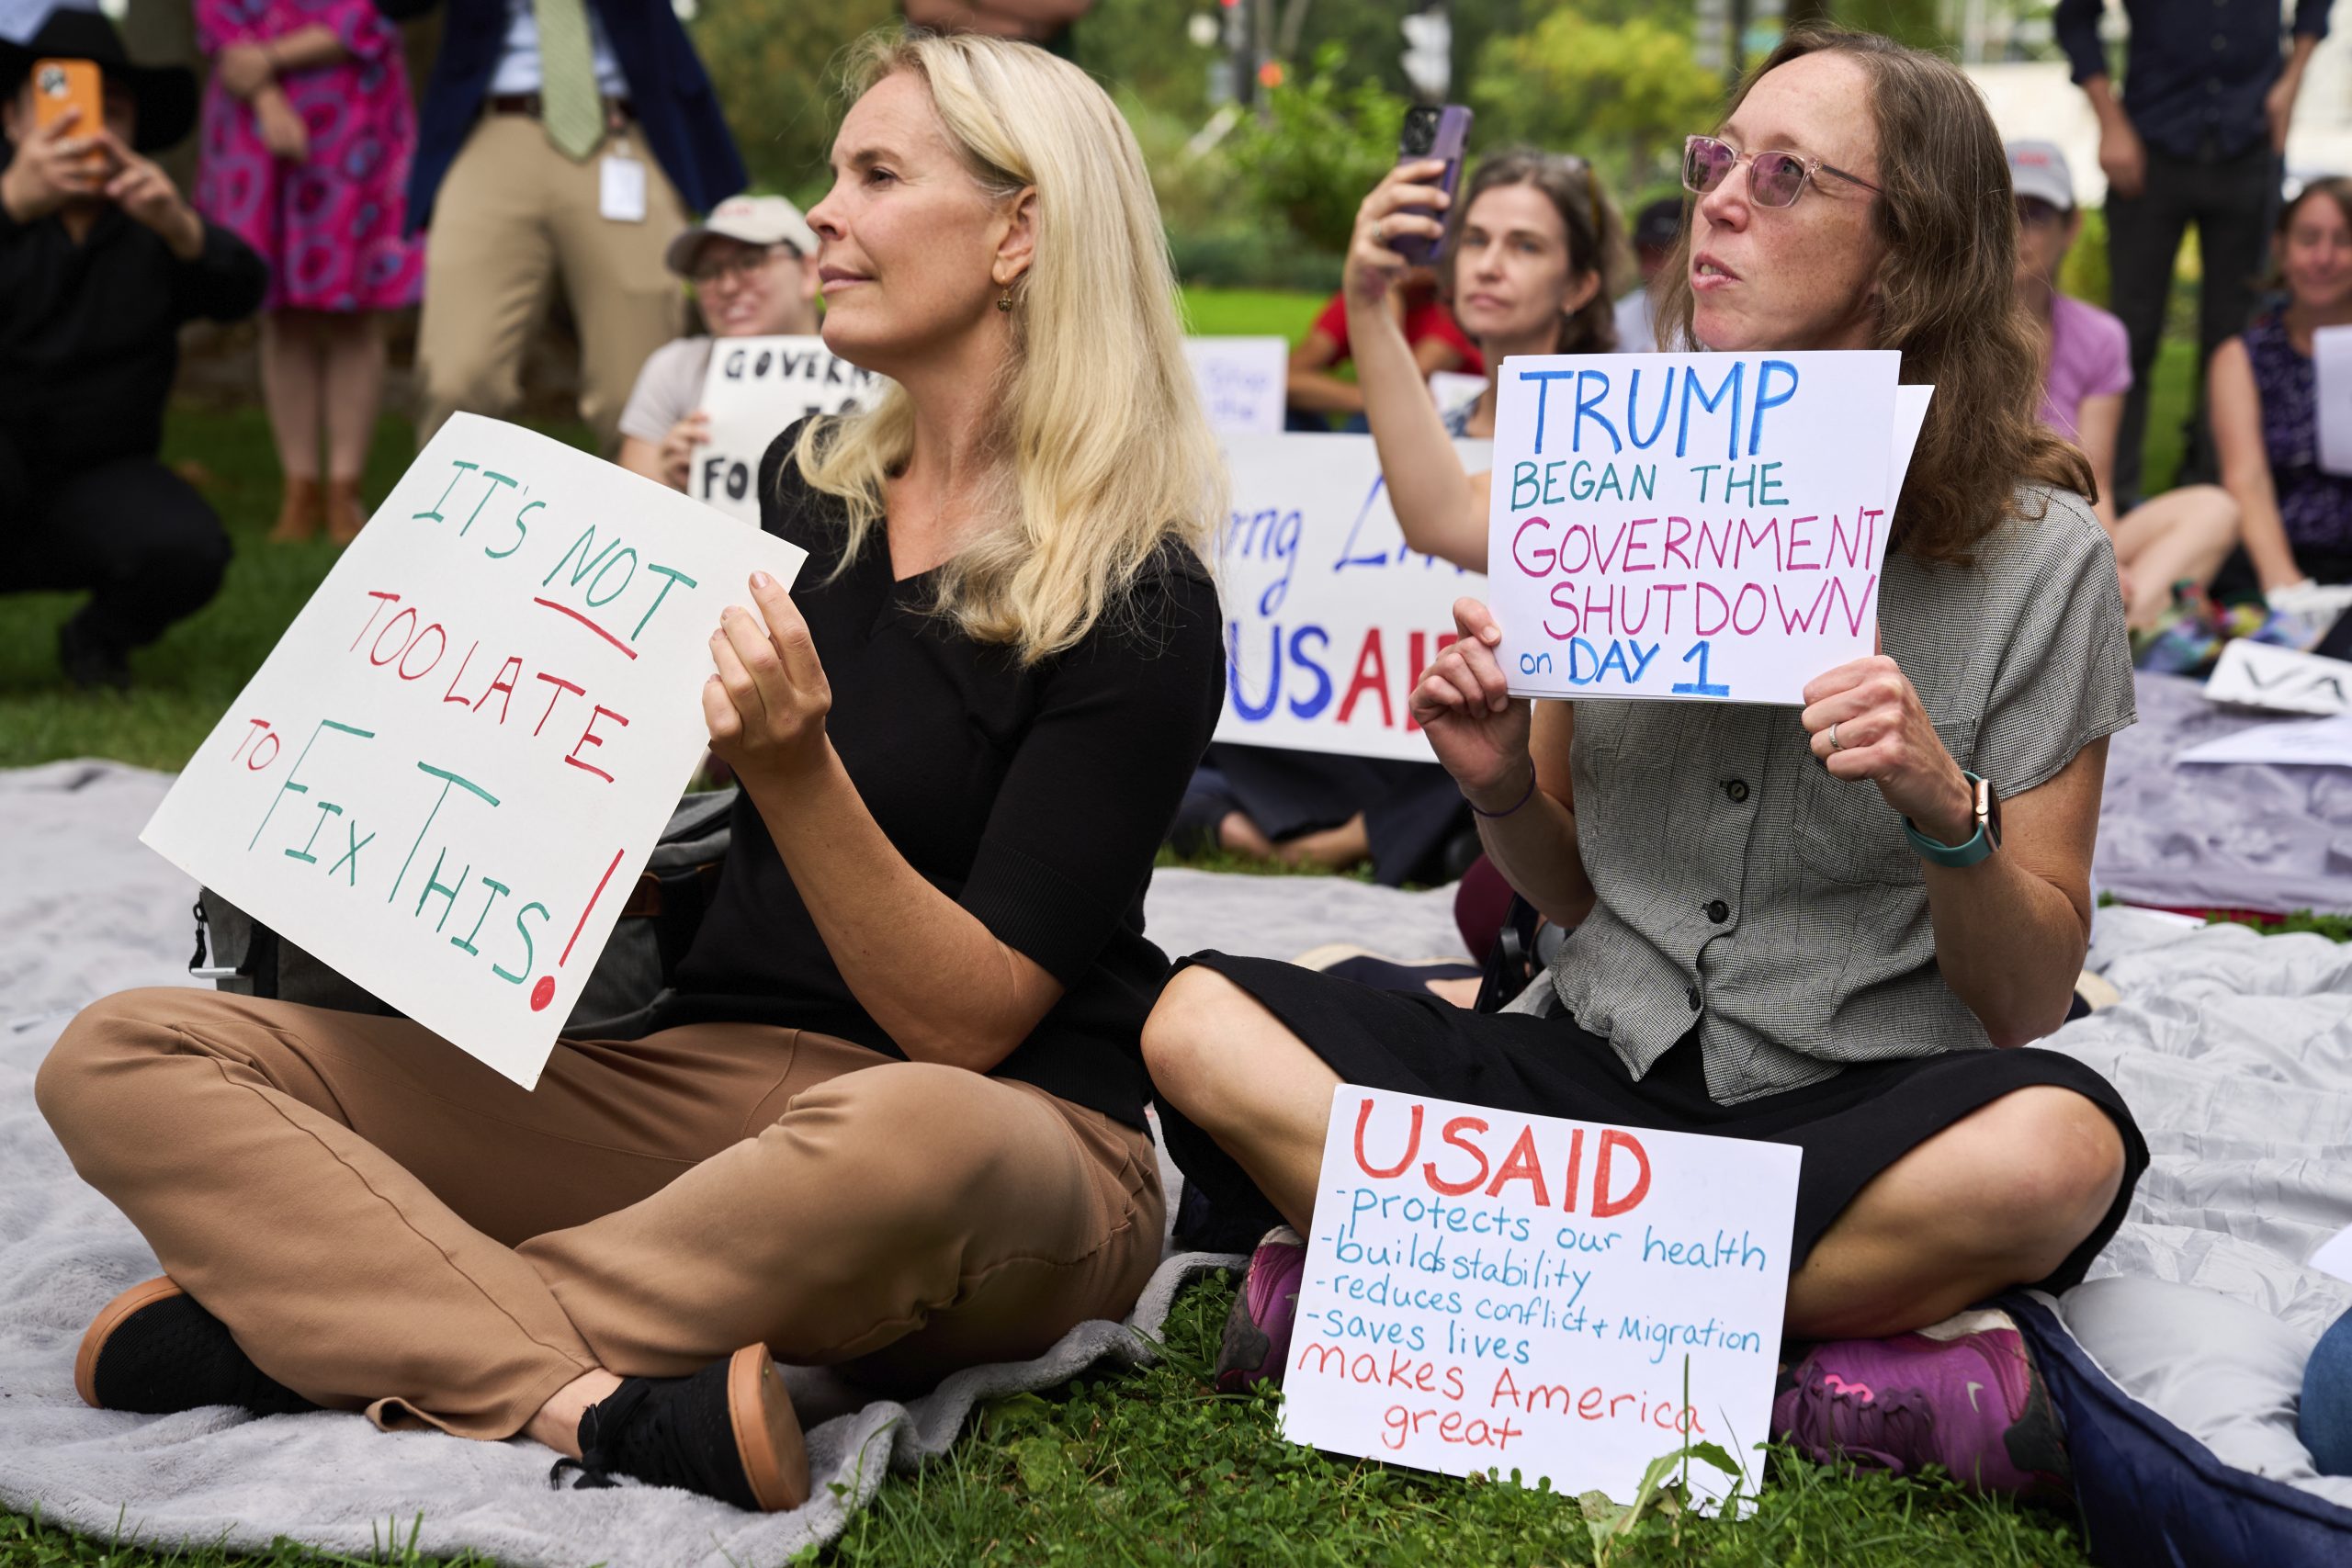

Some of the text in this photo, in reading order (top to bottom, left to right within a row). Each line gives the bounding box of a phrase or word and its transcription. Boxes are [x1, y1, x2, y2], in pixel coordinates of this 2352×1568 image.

[1520, 360, 1799, 461] TRUMP
[1510, 459, 1790, 512] BEGAN THE
[412, 460, 698, 642] IT'S NOT
[1512, 505, 1884, 578] GOVERNMENT
[1544, 574, 1876, 640] SHUTDOWN
[349, 591, 629, 783] TOO LATE
[1520, 637, 1730, 696] on DAY 1
[232, 718, 279, 770] TO
[389, 761, 626, 1012] THIS!
[1353, 1099, 1652, 1218] USAID
[1453, 1248, 1591, 1308] stability
[1556, 1227, 1623, 1253] our
[1643, 1225, 1766, 1271] health
[1449, 1320, 1530, 1365] lives
[1476, 1296, 1588, 1332] conflict
[1382, 1405, 1523, 1450] great
[1490, 1367, 1706, 1435] America
